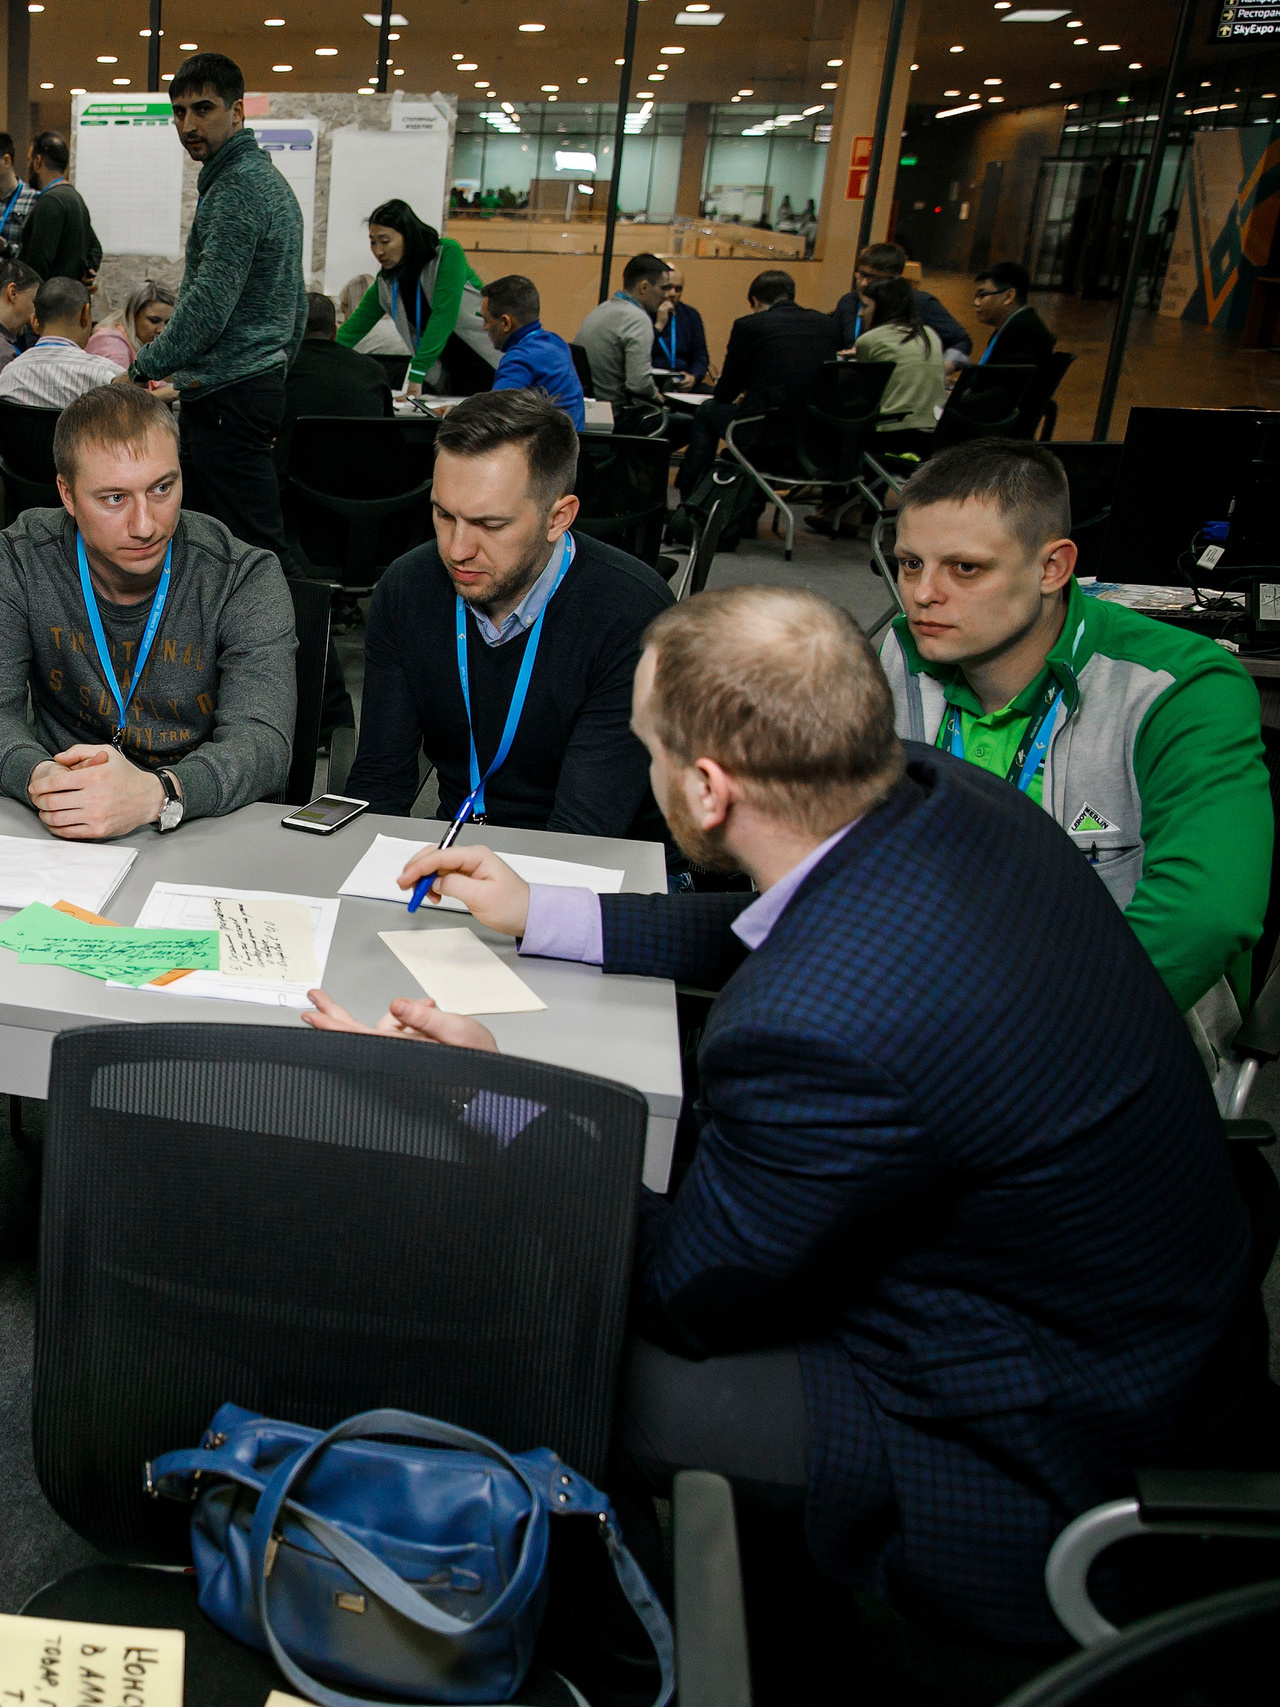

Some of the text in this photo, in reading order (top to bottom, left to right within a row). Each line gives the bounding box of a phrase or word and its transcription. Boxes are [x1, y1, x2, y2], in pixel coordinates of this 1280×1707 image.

[1233, 24, 1275, 36] SkyExpo
[1071, 807, 1109, 831] LEROY MERLIN
